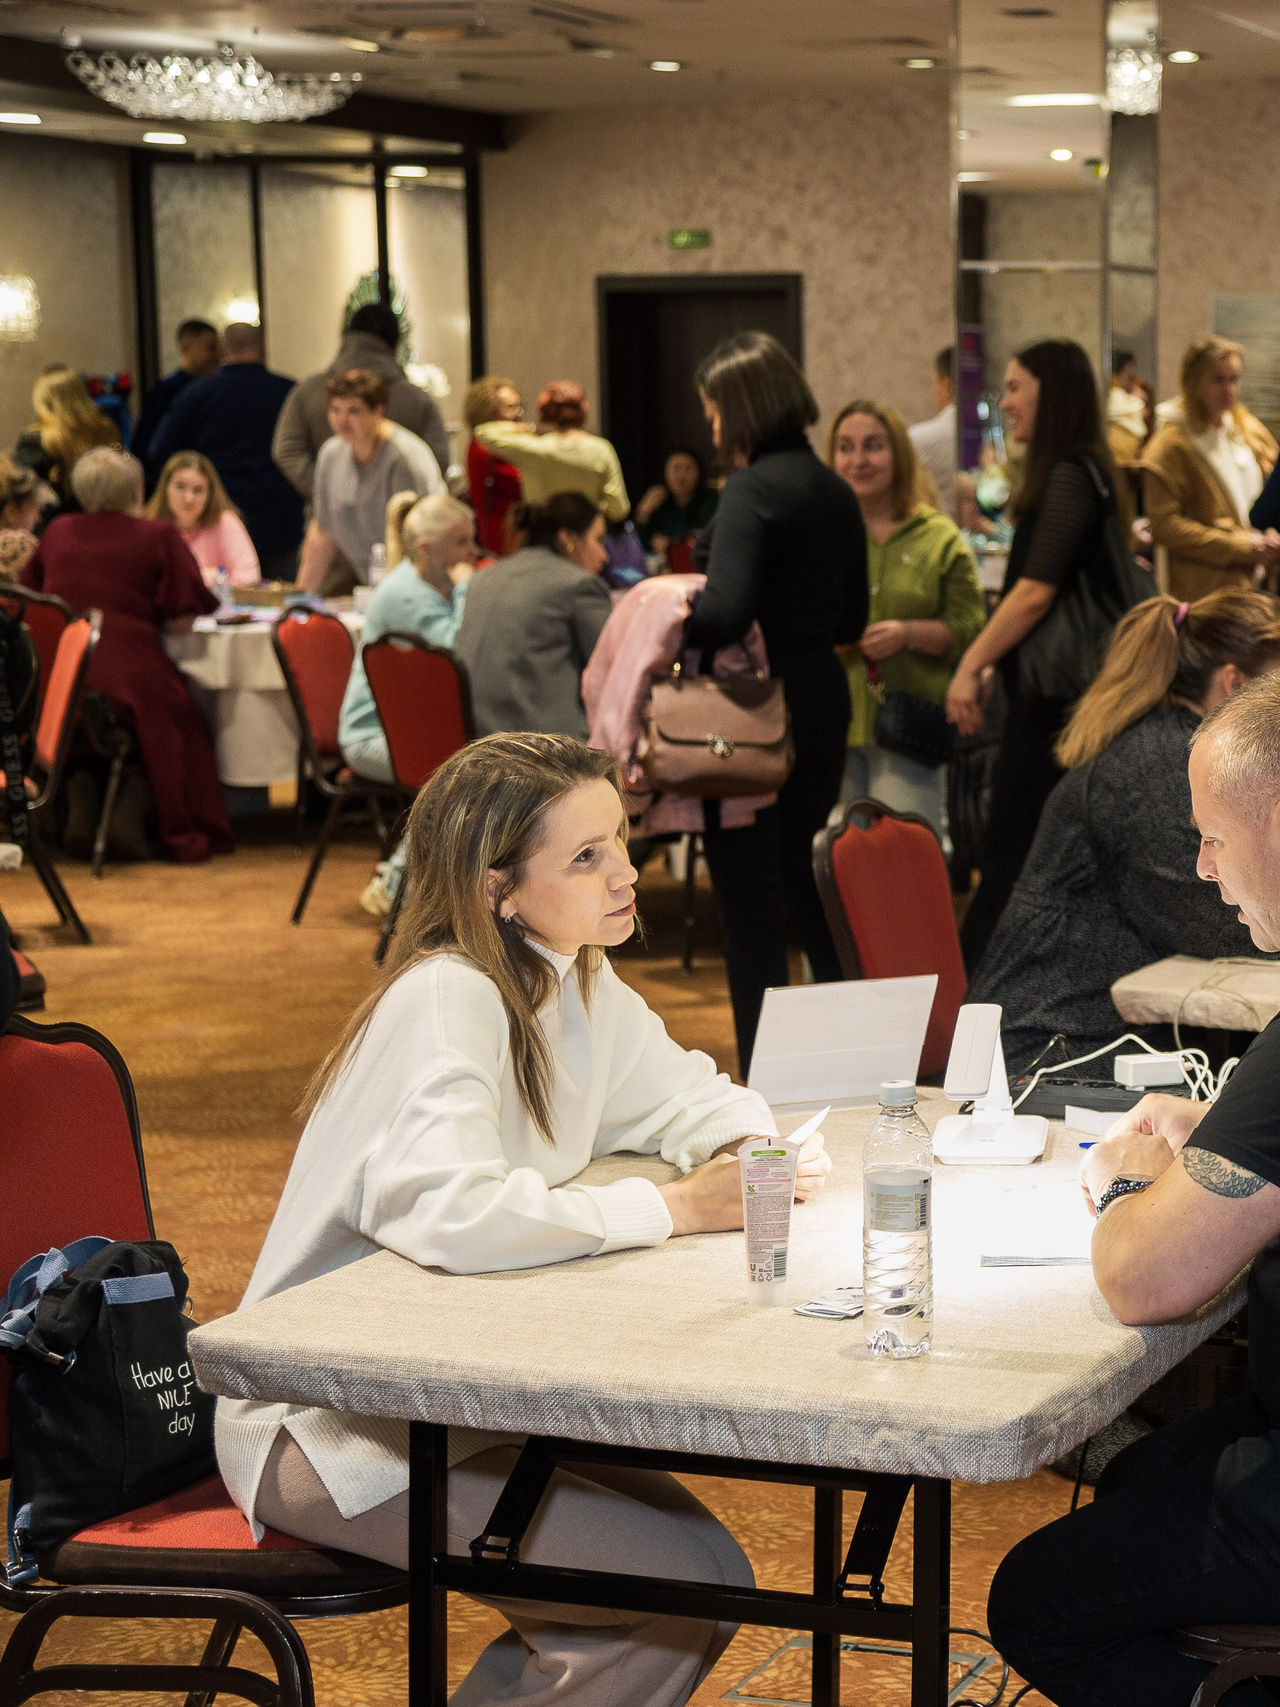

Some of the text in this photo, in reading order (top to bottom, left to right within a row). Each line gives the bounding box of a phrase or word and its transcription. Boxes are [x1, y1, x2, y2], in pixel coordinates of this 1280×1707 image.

[131, 1361, 191, 1389] Have a
[157, 1381, 194, 1410] NICE
[168, 1411, 195, 1436] day
